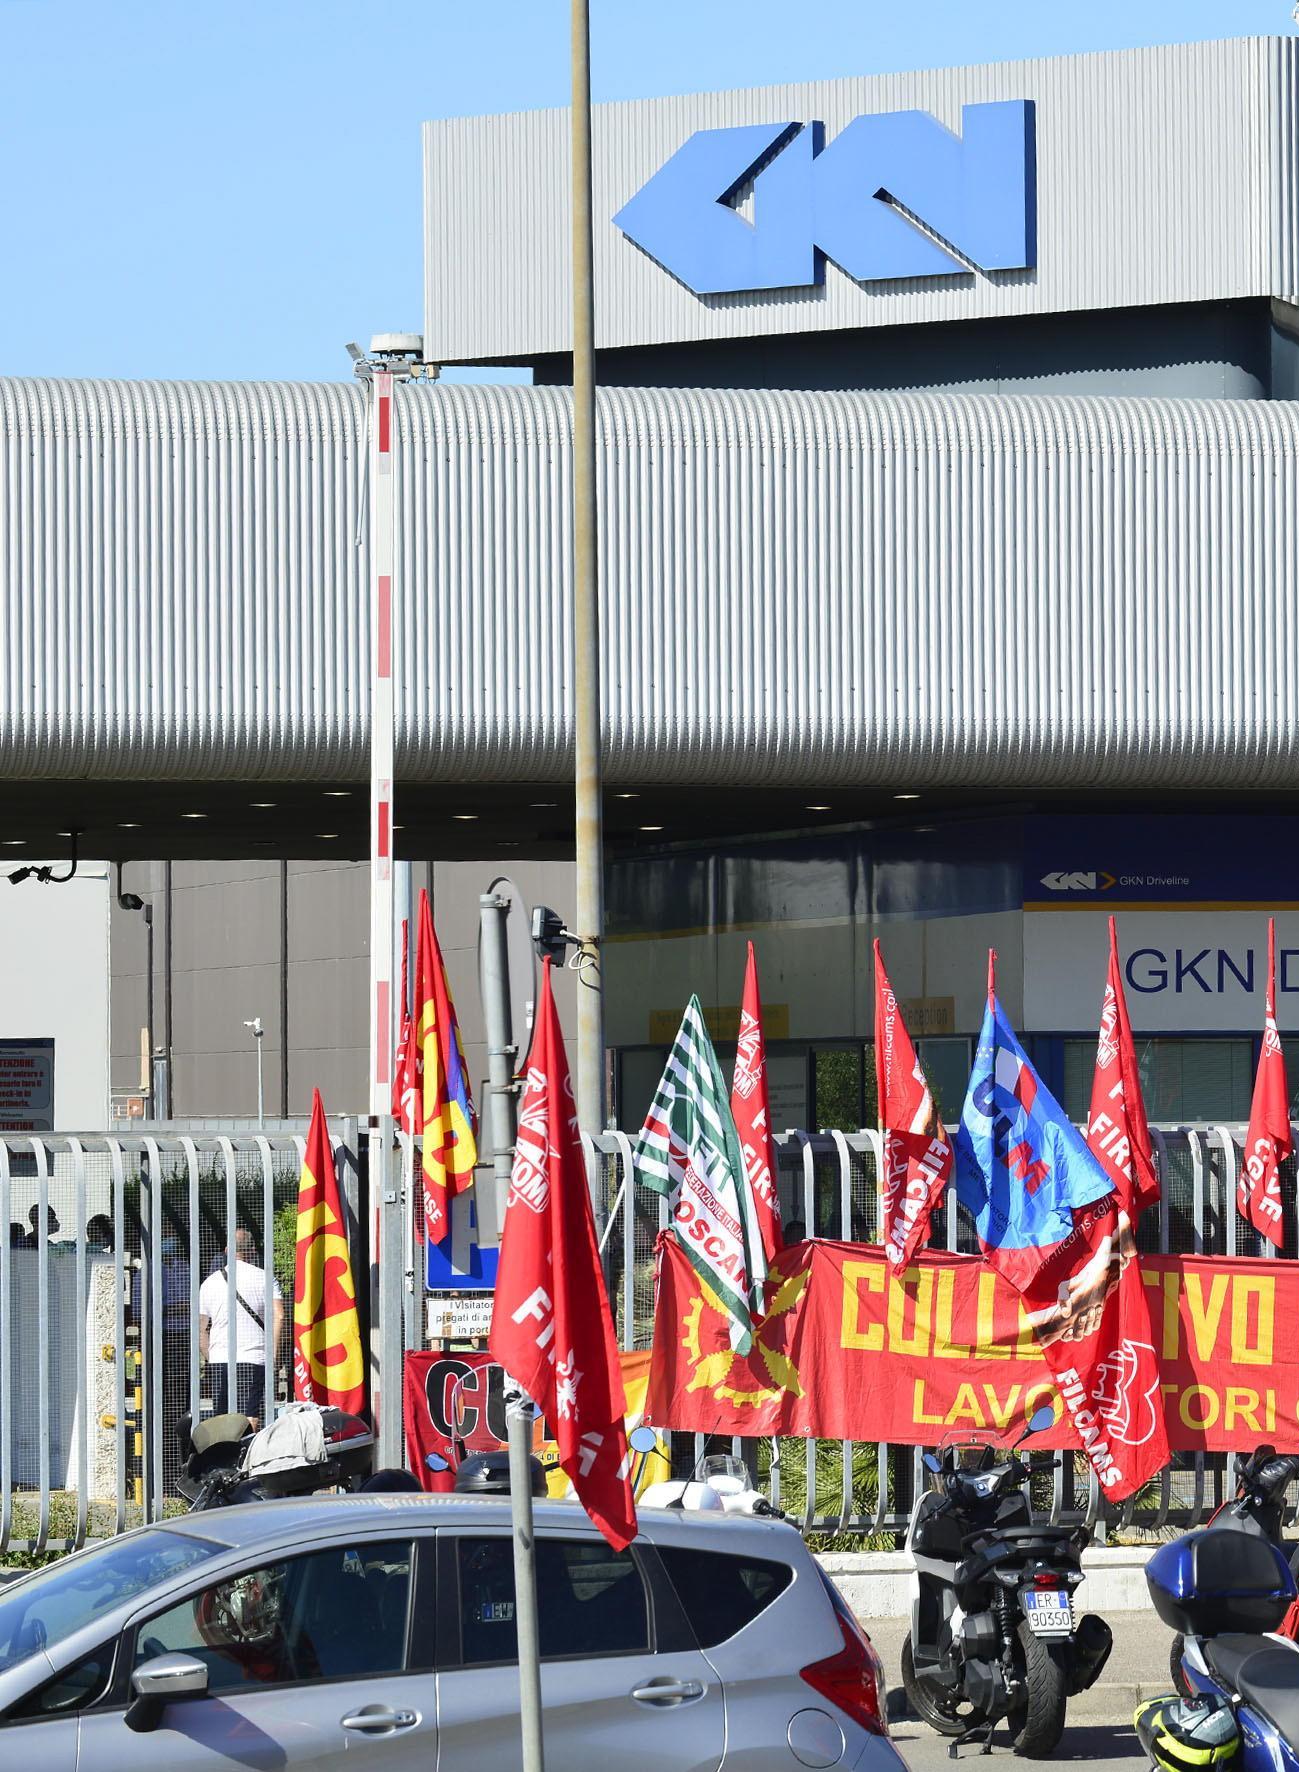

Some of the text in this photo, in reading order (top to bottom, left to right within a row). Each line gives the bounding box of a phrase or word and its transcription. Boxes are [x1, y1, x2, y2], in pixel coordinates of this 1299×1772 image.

[611, 99, 1037, 296] GKN
[1040, 872, 1097, 890] GKN
[1119, 876, 1190, 886] GKN Driveline
[1125, 948, 1254, 993] GKN
[455, 1301, 494, 1310] Visitator
[436, 1313, 469, 1324] pregati
[472, 1313, 480, 1321] di
[458, 1326, 467, 1334] in
[1056, 1367, 1124, 1489] FILCAMS
[1037, 1593, 1053, 1607] ER
[1031, 1612, 1070, 1627] 90350
